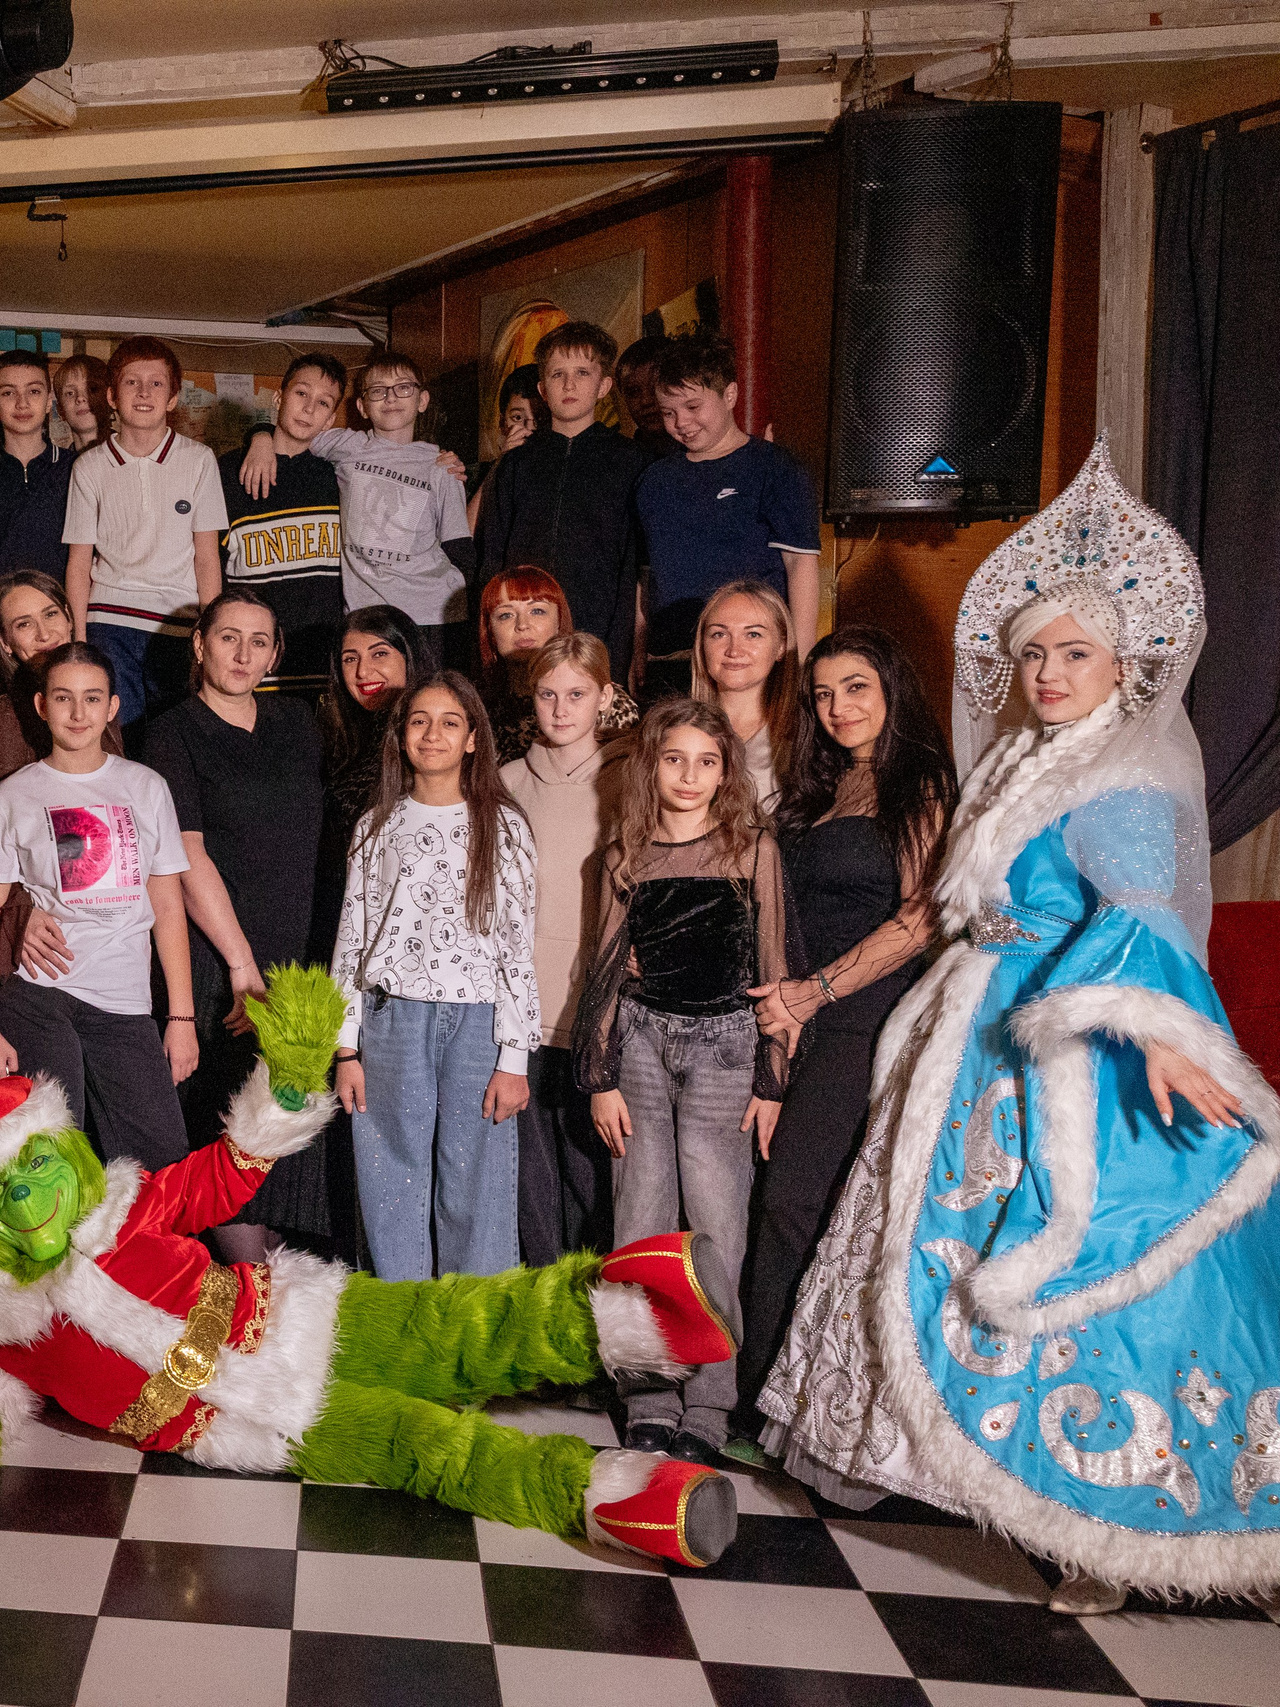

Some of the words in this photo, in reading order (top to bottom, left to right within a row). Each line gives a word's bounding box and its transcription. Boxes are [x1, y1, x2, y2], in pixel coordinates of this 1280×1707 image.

[354, 462, 432, 491] SKATEBOARDING
[242, 522, 341, 568] UNREAL
[122, 807, 133, 826] MOON
[127, 828, 136, 839] ON
[129, 841, 139, 865] WALK
[132, 867, 141, 886] MEN
[85, 897, 94, 905] to
